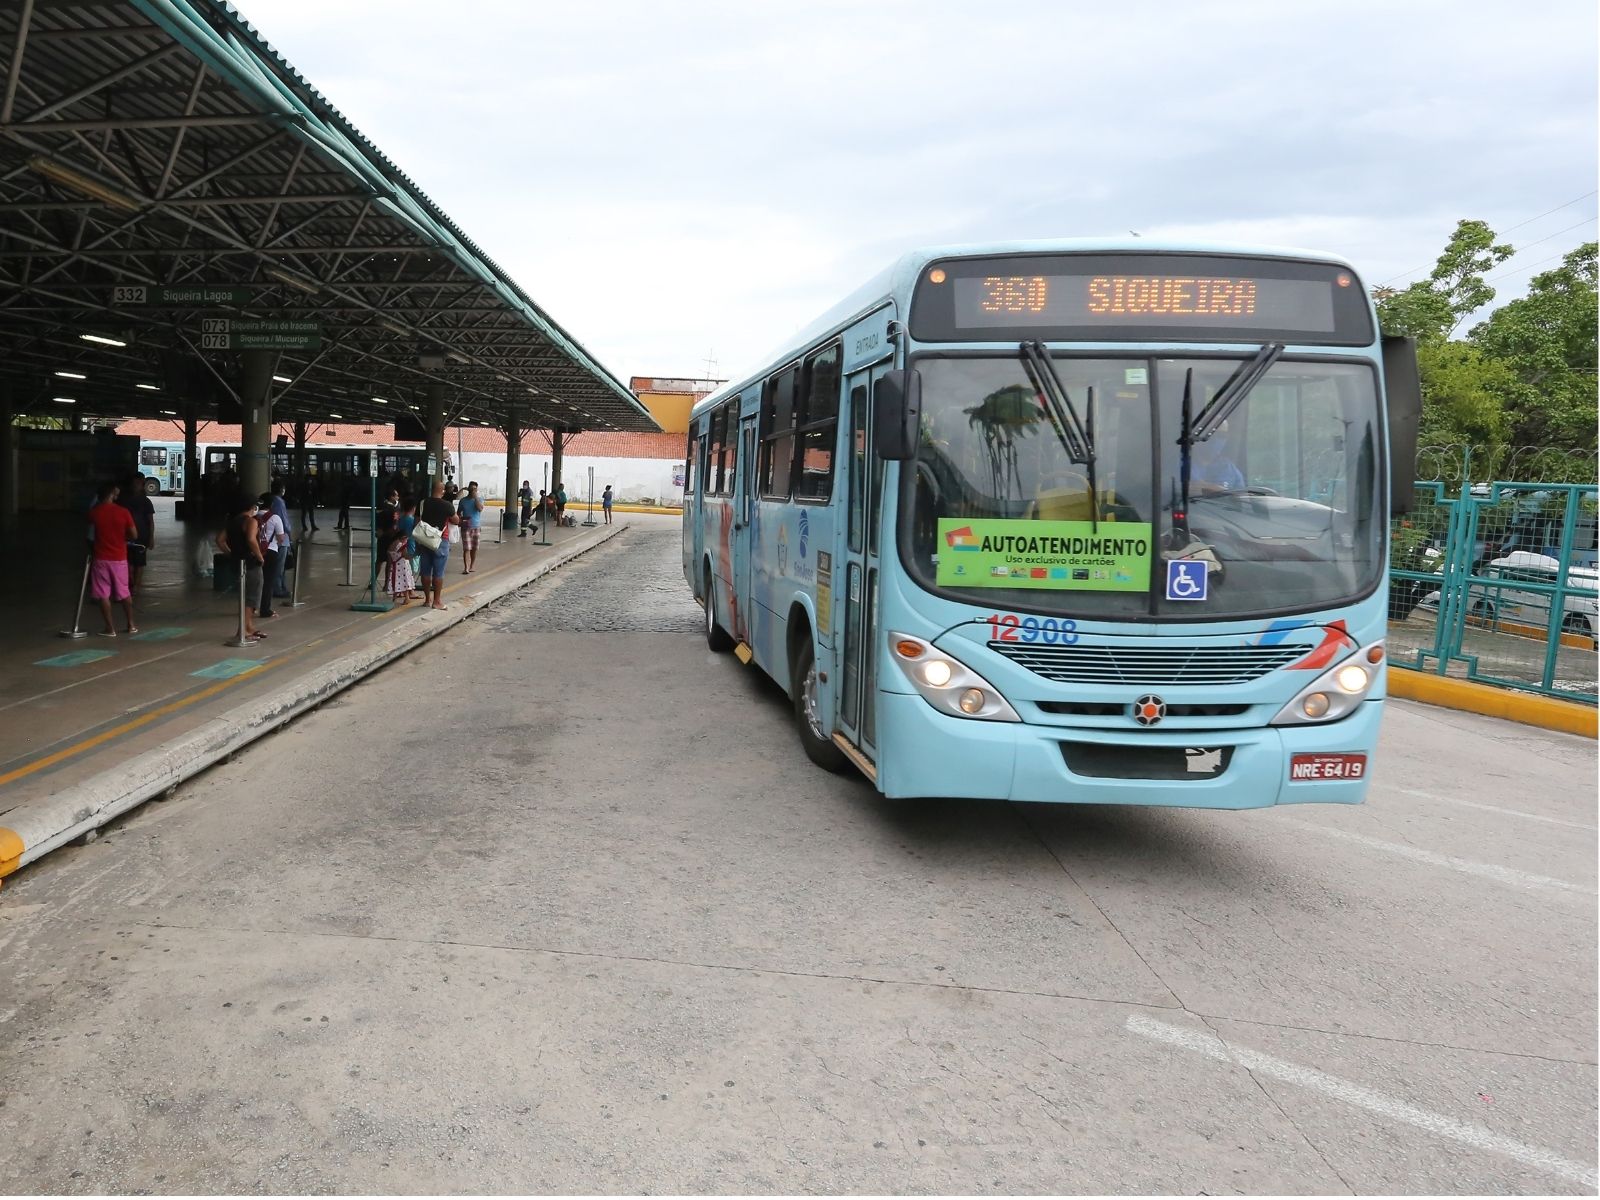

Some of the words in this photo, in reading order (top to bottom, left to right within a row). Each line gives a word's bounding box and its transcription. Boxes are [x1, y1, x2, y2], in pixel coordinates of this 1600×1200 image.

[117, 288, 144, 301] 332
[163, 289, 201, 303] Siqueira
[204, 290, 233, 302] Lagoa
[982, 276, 1048, 311] 360
[1088, 277, 1257, 315] SIQUEIRA
[203, 319, 227, 333] 073
[231, 321, 259, 332] Siqueira
[279, 321, 289, 330] de
[290, 321, 318, 331] Iracema
[203, 335, 227, 347] 078
[240, 334, 269, 344] Siqueira
[275, 335, 309, 345] Mucuripe
[980, 535, 1148, 557] AUTOATENDIMENTO
[1005, 555, 1022, 565] Uso
[1024, 556, 1067, 566] exclusivo
[1069, 556, 1081, 566] de
[1083, 556, 1116, 567] cartões
[986, 613, 1079, 644] 12908
[1292, 762, 1362, 778] NRE-6419
